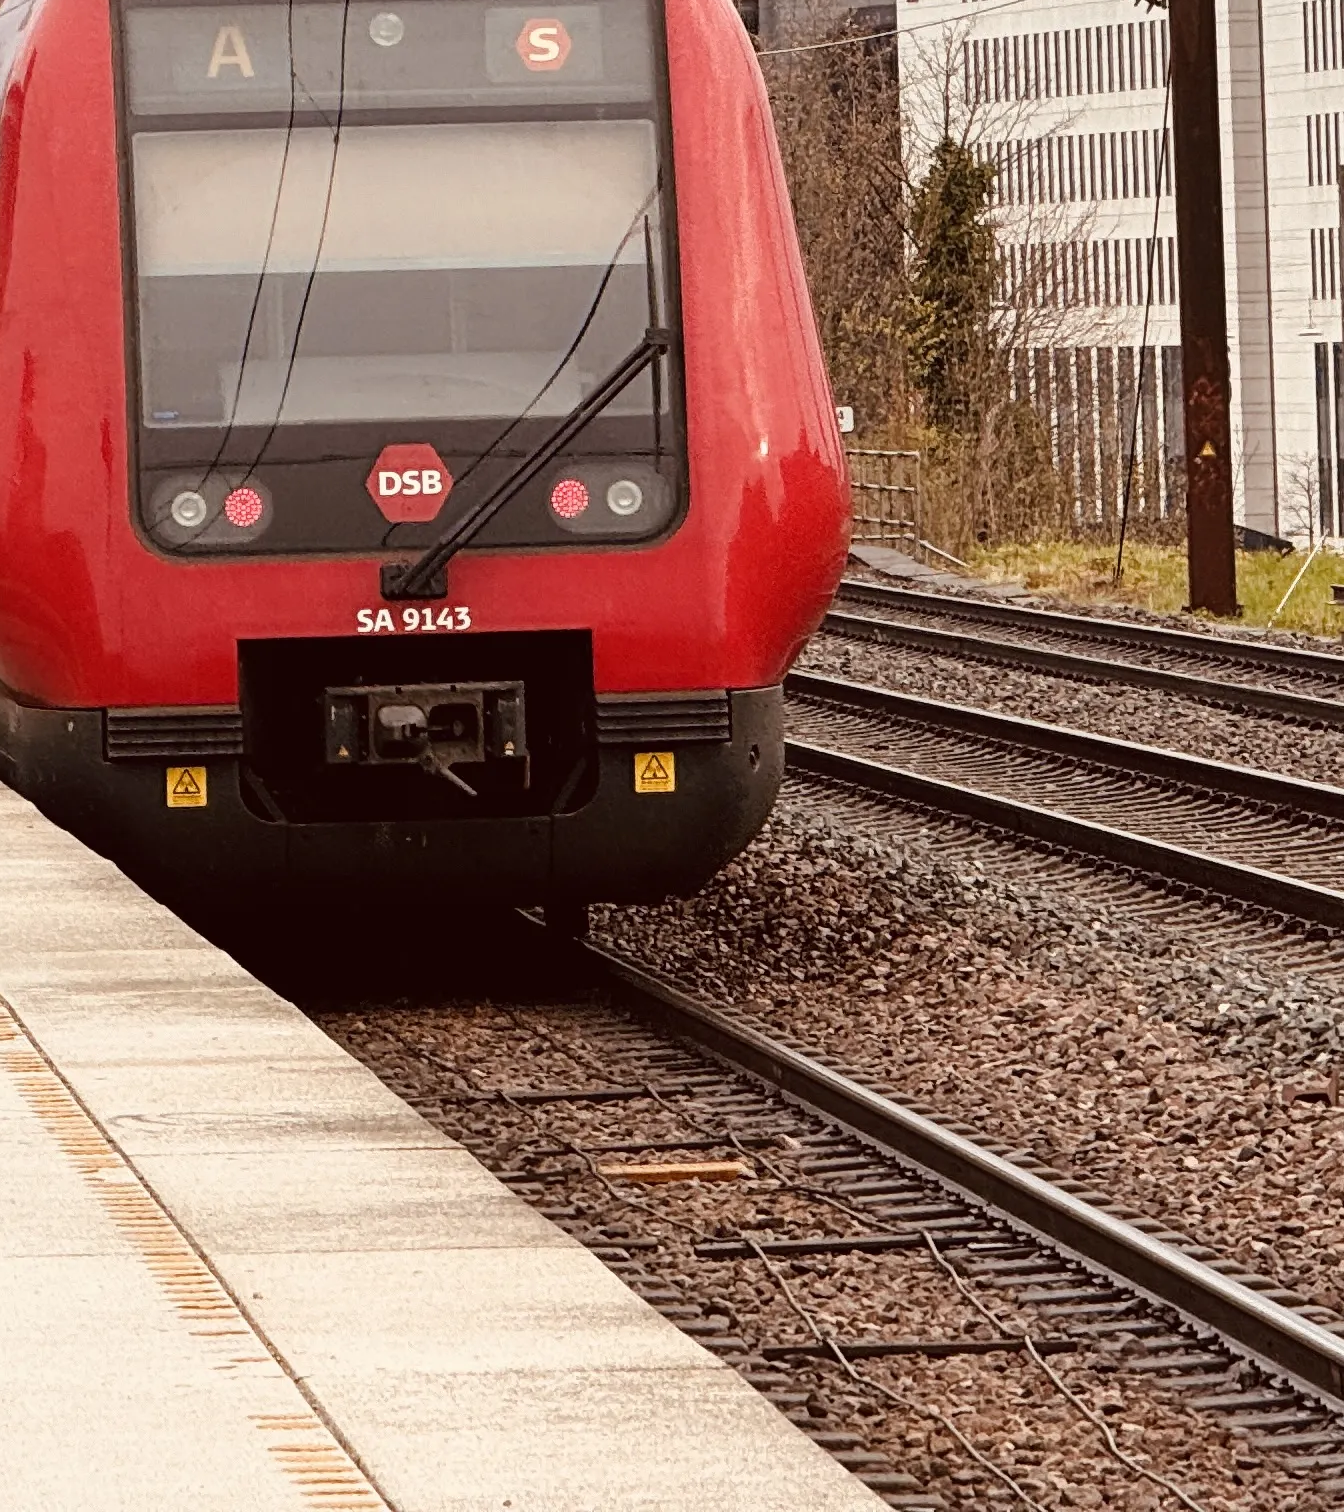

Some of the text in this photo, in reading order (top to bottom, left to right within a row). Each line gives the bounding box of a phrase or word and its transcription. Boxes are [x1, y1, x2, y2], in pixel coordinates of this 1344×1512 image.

[207, 27, 255, 77] A
[528, 28, 560, 61] S
[378, 470, 443, 496] DSB
[357, 607, 471, 633] SA 9143
